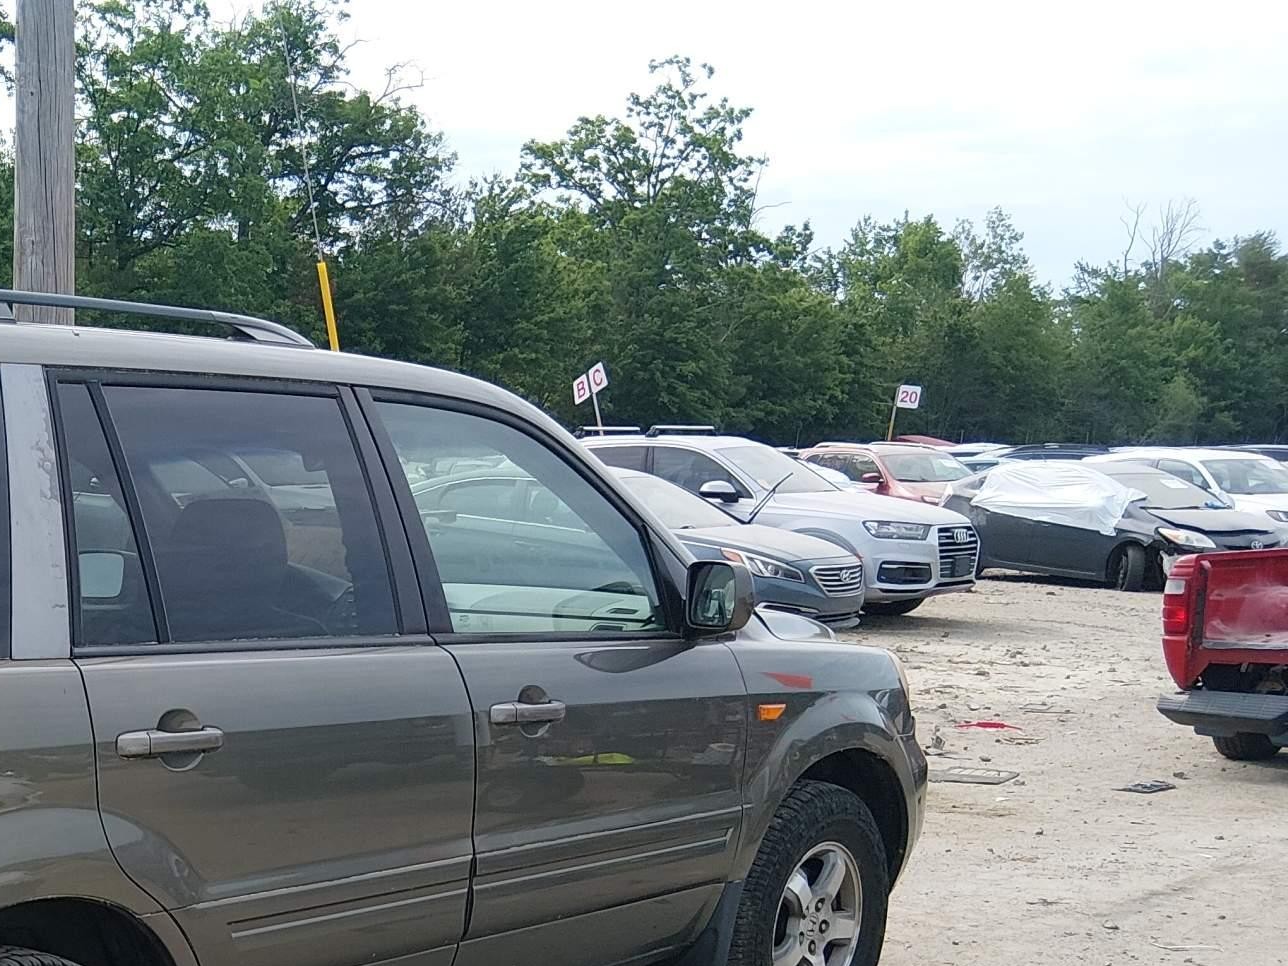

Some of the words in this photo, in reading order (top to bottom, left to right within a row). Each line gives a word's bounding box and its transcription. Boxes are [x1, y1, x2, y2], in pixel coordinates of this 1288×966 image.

[576, 380, 586, 399] B
[592, 368, 603, 387] C
[899, 390, 918, 404] 20
